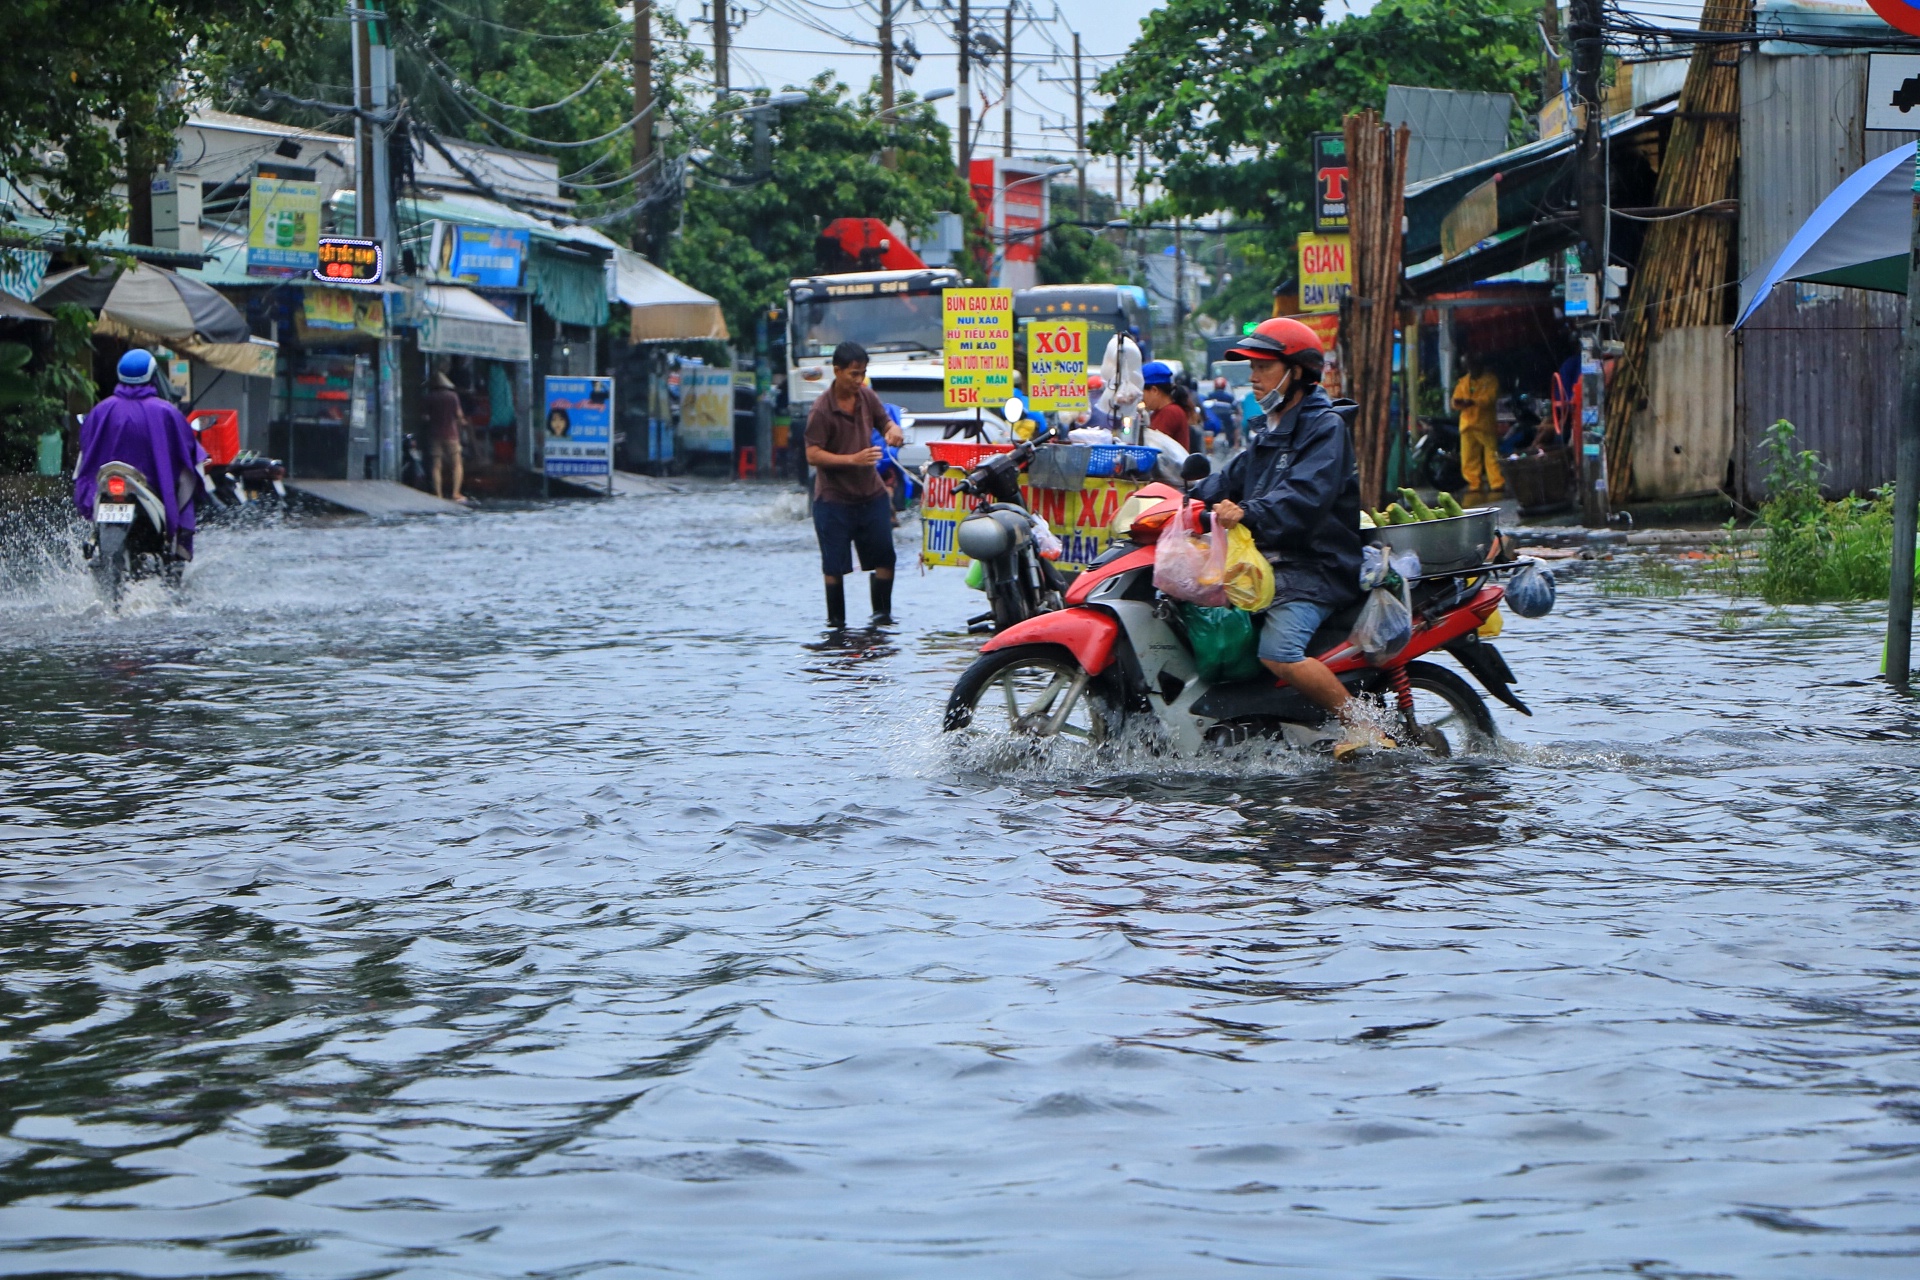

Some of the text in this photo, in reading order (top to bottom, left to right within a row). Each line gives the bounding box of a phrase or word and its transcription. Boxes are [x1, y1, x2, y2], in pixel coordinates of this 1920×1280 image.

[1321, 138, 1345, 158] TIỆ
[1303, 238, 1345, 274] GIÀN
[946, 293, 1008, 314] BÚN GẠO XÀO
[1304, 279, 1325, 305] BÁN
[957, 316, 975, 325] NUI
[1036, 325, 1081, 353] XÔI
[1031, 358, 1052, 377] MẶN
[1059, 361, 1084, 376] NGỌT
[950, 375, 974, 385] CHAY
[1077, 477, 1135, 528] XÀ
[927, 519, 957, 559] THỊT
